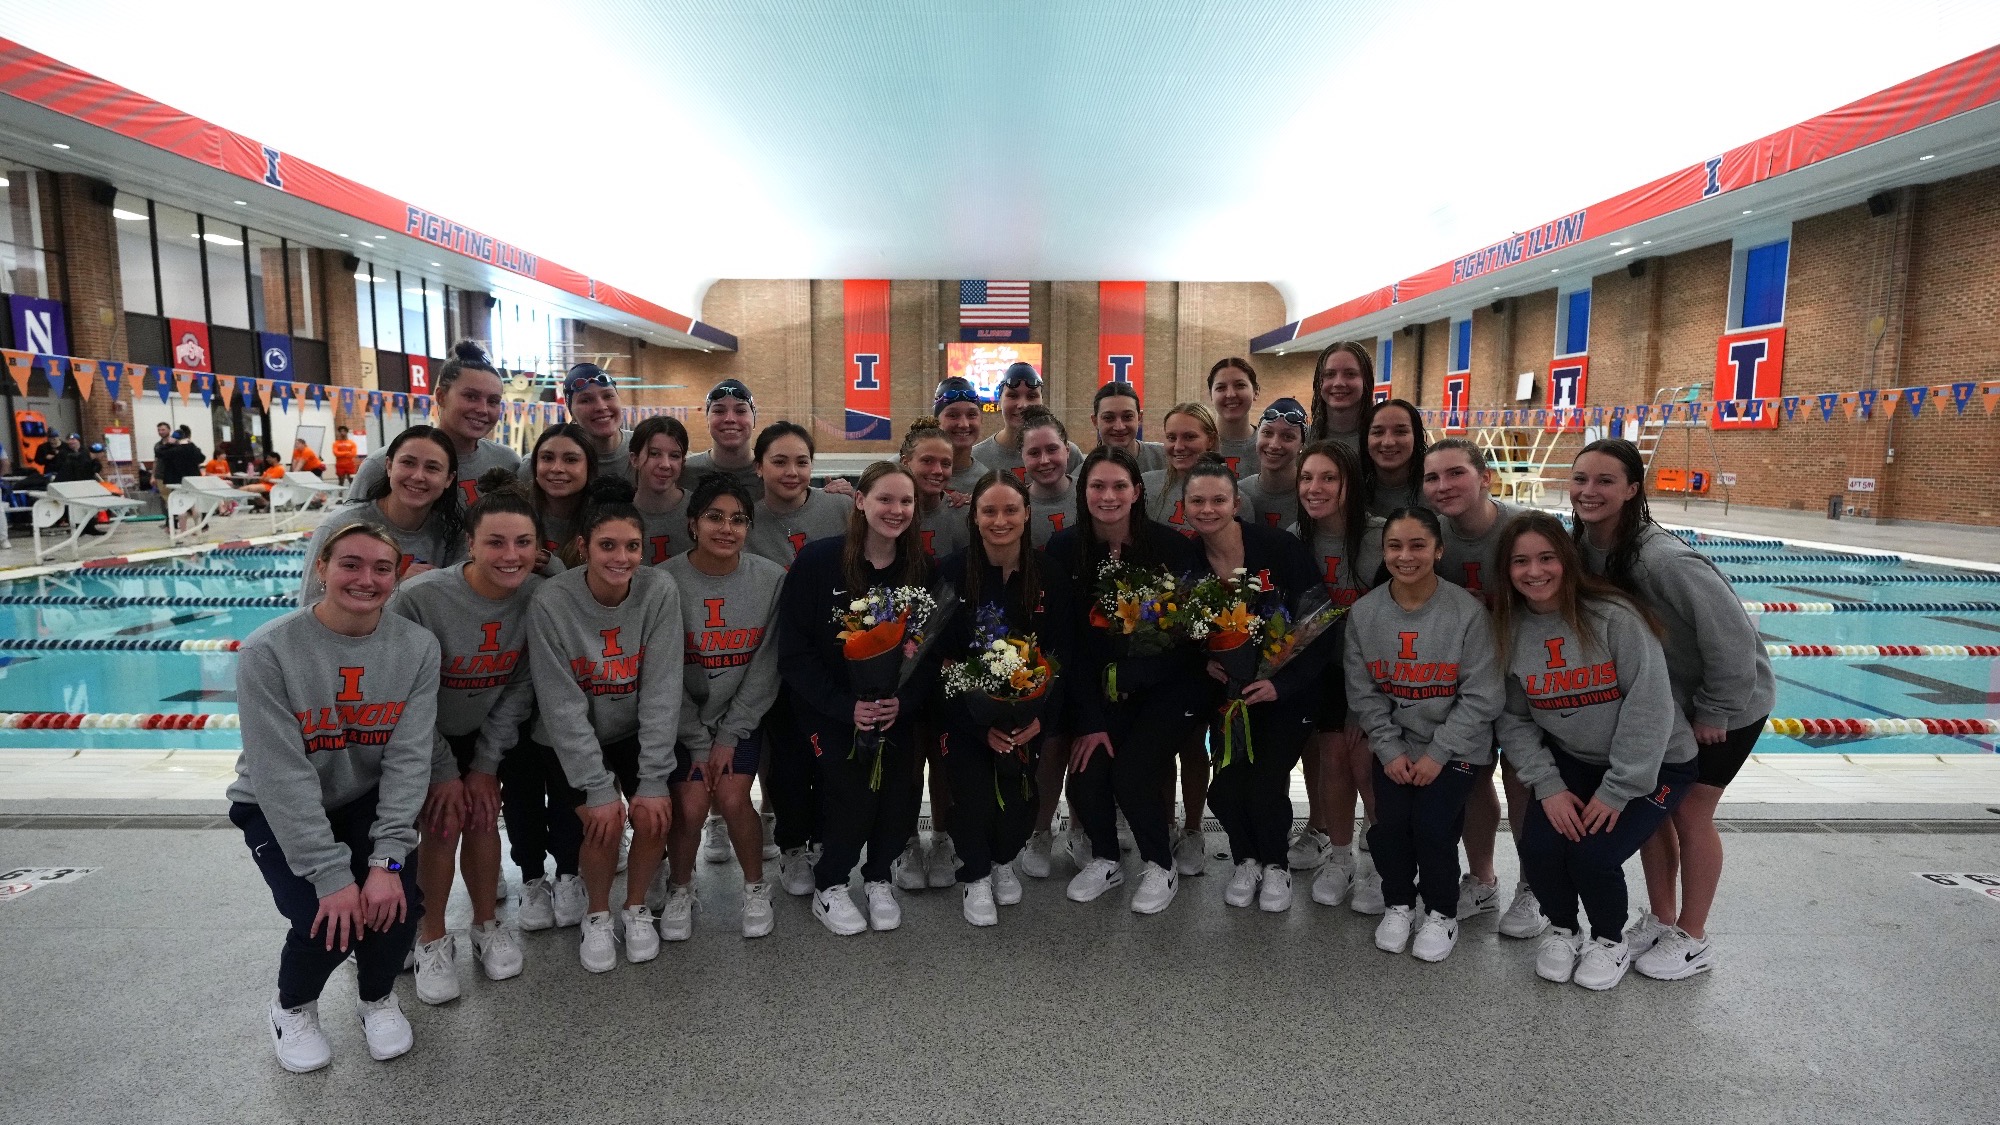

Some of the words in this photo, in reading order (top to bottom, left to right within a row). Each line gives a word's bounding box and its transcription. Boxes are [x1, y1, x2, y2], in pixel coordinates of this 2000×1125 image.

[262, 145, 283, 190] I
[1703, 155, 1723, 199] I
[406, 205, 493, 262] FIGHTING
[495, 241, 538, 279] ILLINI
[1452, 233, 1526, 285] FIGHTING
[1526, 210, 1587, 259] ILLINI
[24, 309, 55, 354] N
[49, 360, 61, 376] I
[106, 366, 117, 381] I
[411, 364, 426, 388] R
[854, 354, 880, 390] I
[1108, 355, 1134, 387] I
[1724, 338, 1769, 421] I
[1446, 379, 1464, 429] I
[1864, 393, 1871, 405] I
[1912, 391, 1920, 404] I
[1959, 386, 1967, 400] I
[651, 535, 672, 564] I
[1257, 569, 1274, 592] I
[1322, 556, 1341, 584] I
[1463, 562, 1482, 590] I
[704, 597, 726, 628] I
[478, 621, 502, 652] I
[600, 626, 623, 658] I
[1398, 631, 1418, 660] I
[724, 656, 731, 666] &
[1544, 637, 1567, 669] I
[336, 666, 365, 701] I
[488, 676, 496, 687] &
[1412, 688, 1420, 698] &
[1421, 685, 1456, 697] DIVING
[1572, 697, 1579, 707] &
[1581, 688, 1620, 705] DIVING
[349, 731, 357, 742] &
[810, 733, 822, 757] I
[1655, 785, 1670, 804] I
